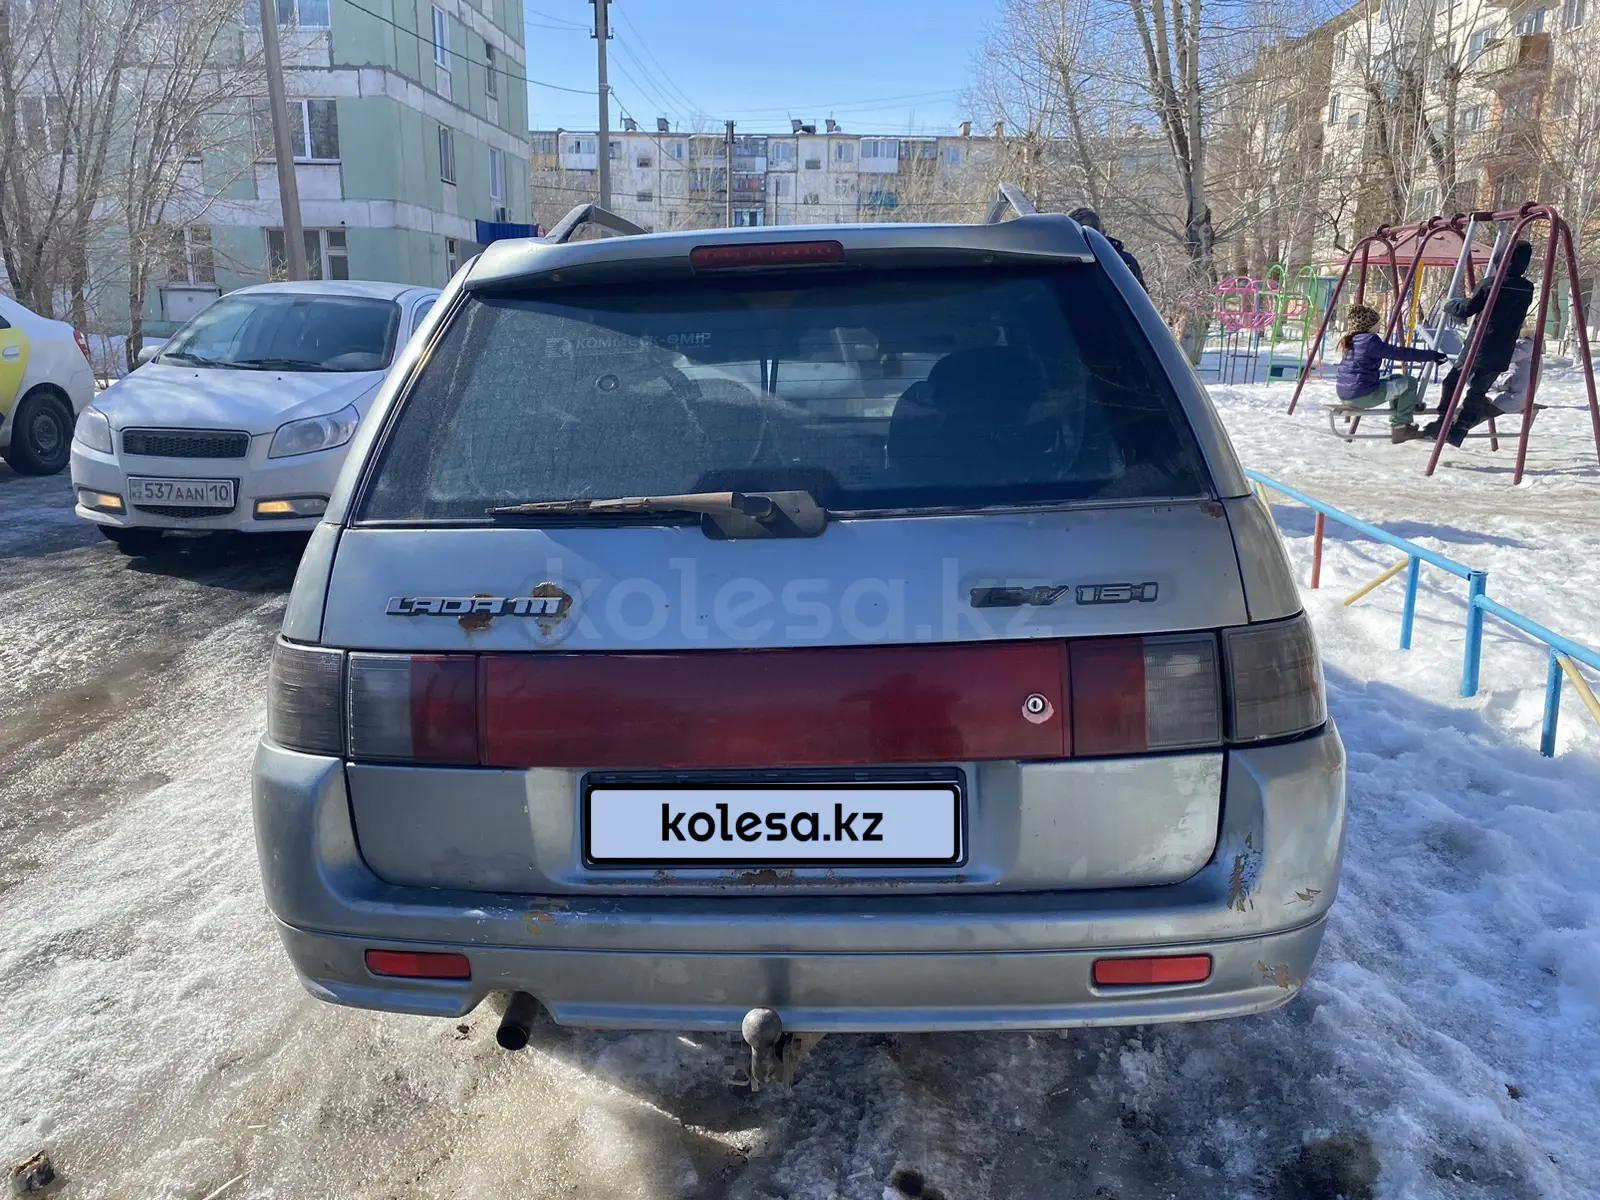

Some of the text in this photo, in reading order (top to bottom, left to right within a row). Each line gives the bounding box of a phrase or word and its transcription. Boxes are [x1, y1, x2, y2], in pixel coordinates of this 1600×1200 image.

[144, 482, 205, 501] 537AAN
[209, 484, 229, 501] 10
[384, 597, 504, 616] LADA
